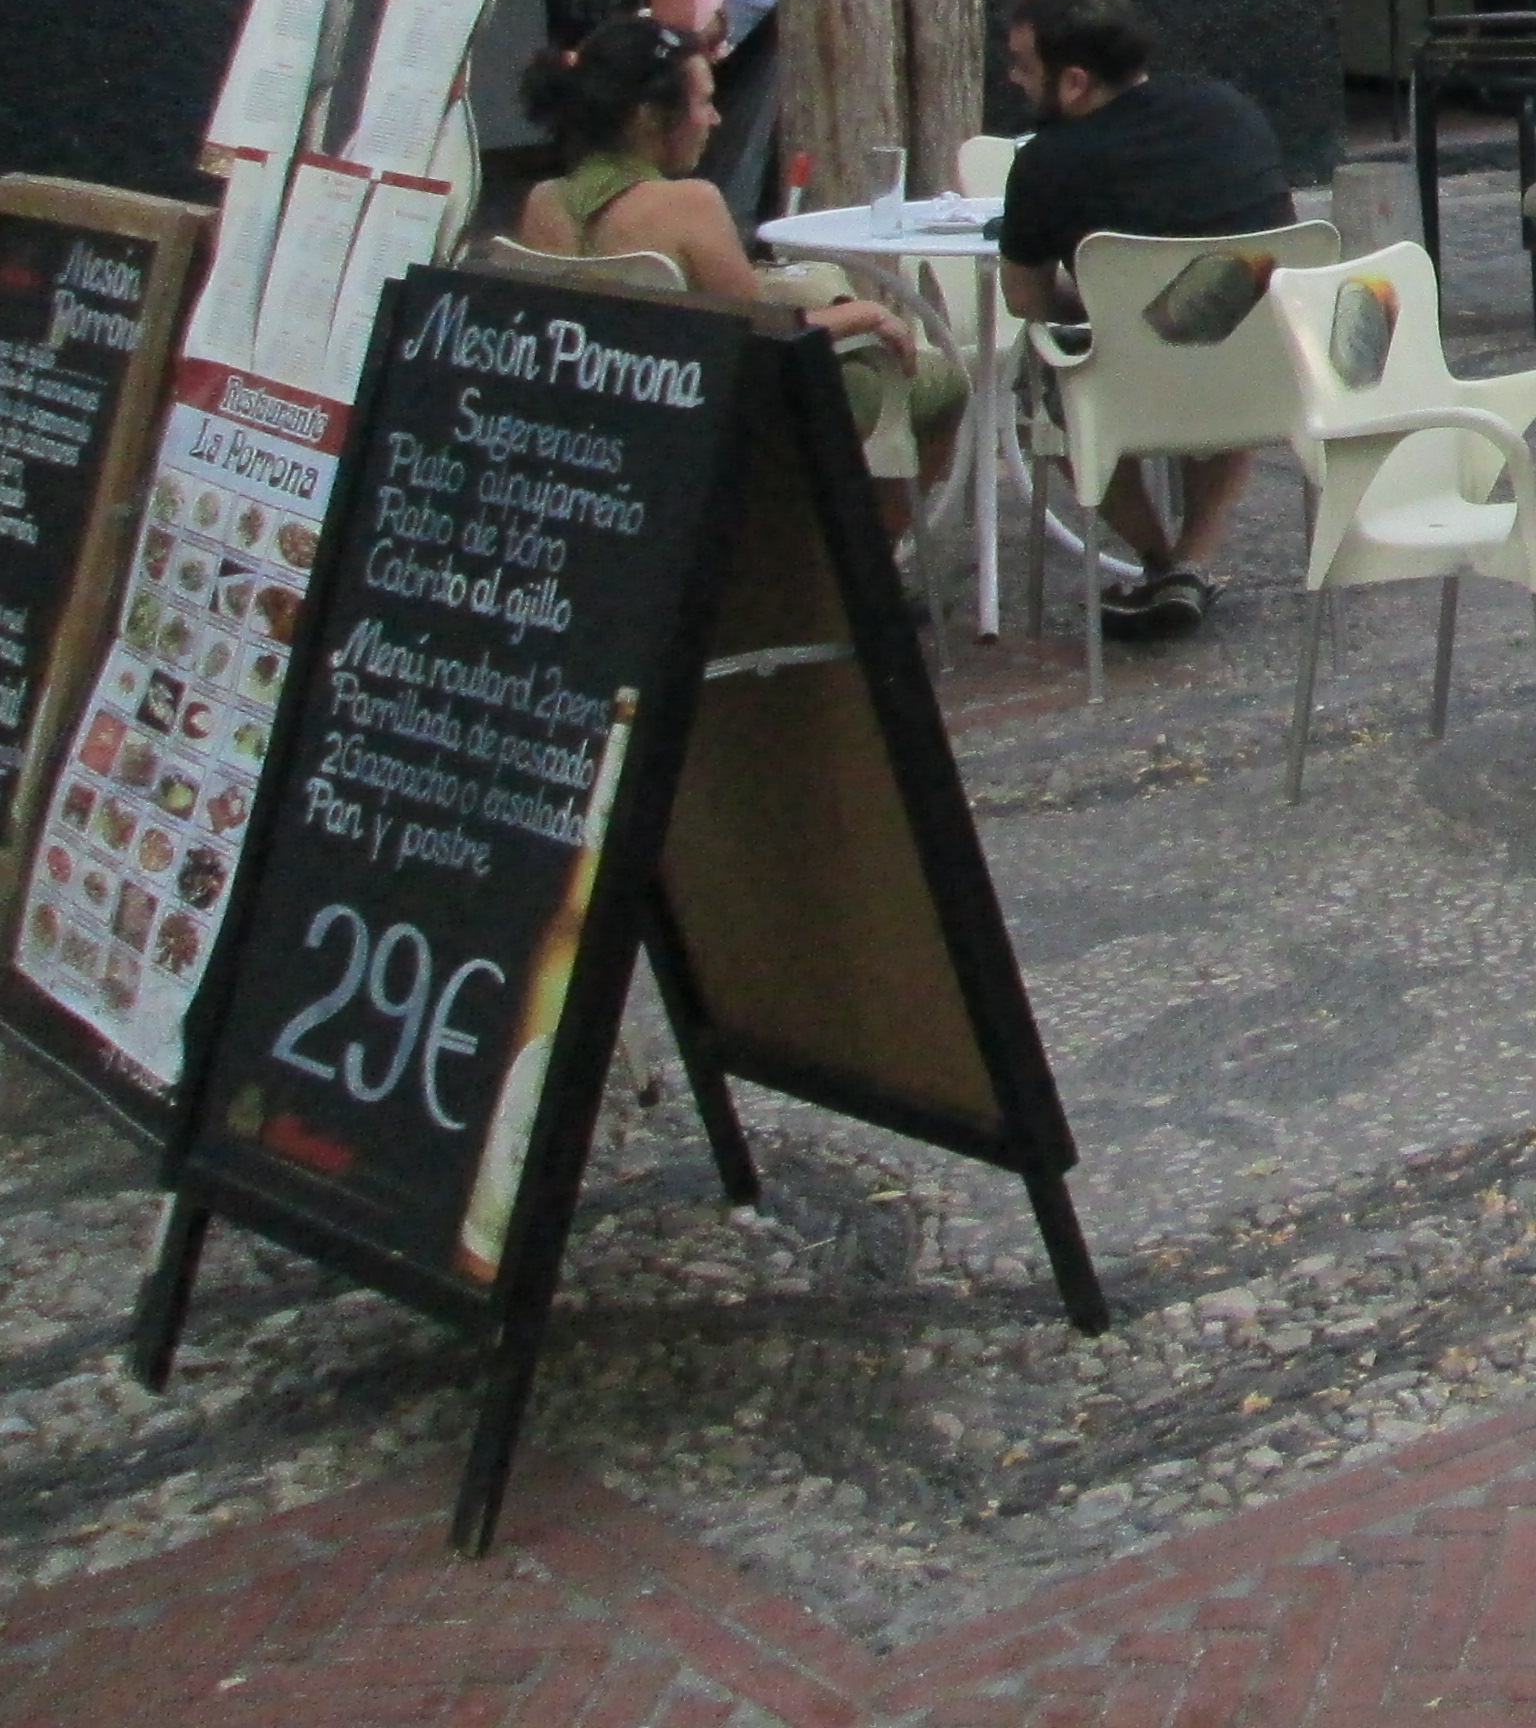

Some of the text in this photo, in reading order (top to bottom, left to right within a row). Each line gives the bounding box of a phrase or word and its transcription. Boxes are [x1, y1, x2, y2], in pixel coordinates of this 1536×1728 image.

[403, 291, 705, 409] Mesón Porrona
[219, 374, 330, 444] Restaurante
[455, 387, 627, 472] Sugerencias
[189, 417, 320, 500] La Porrona
[388, 432, 466, 494] Plato
[376, 485, 454, 546] Rabo
[462, 506, 499, 556] de
[368, 537, 467, 608] Cabrito
[470, 567, 502, 617] al
[331, 618, 430, 684] Menú
[331, 671, 595, 790] Parrillada de pescado
[305, 775, 492, 877] Pan y postre
[461, 780, 480, 815] o
[272, 903, 506, 1130] 29€
